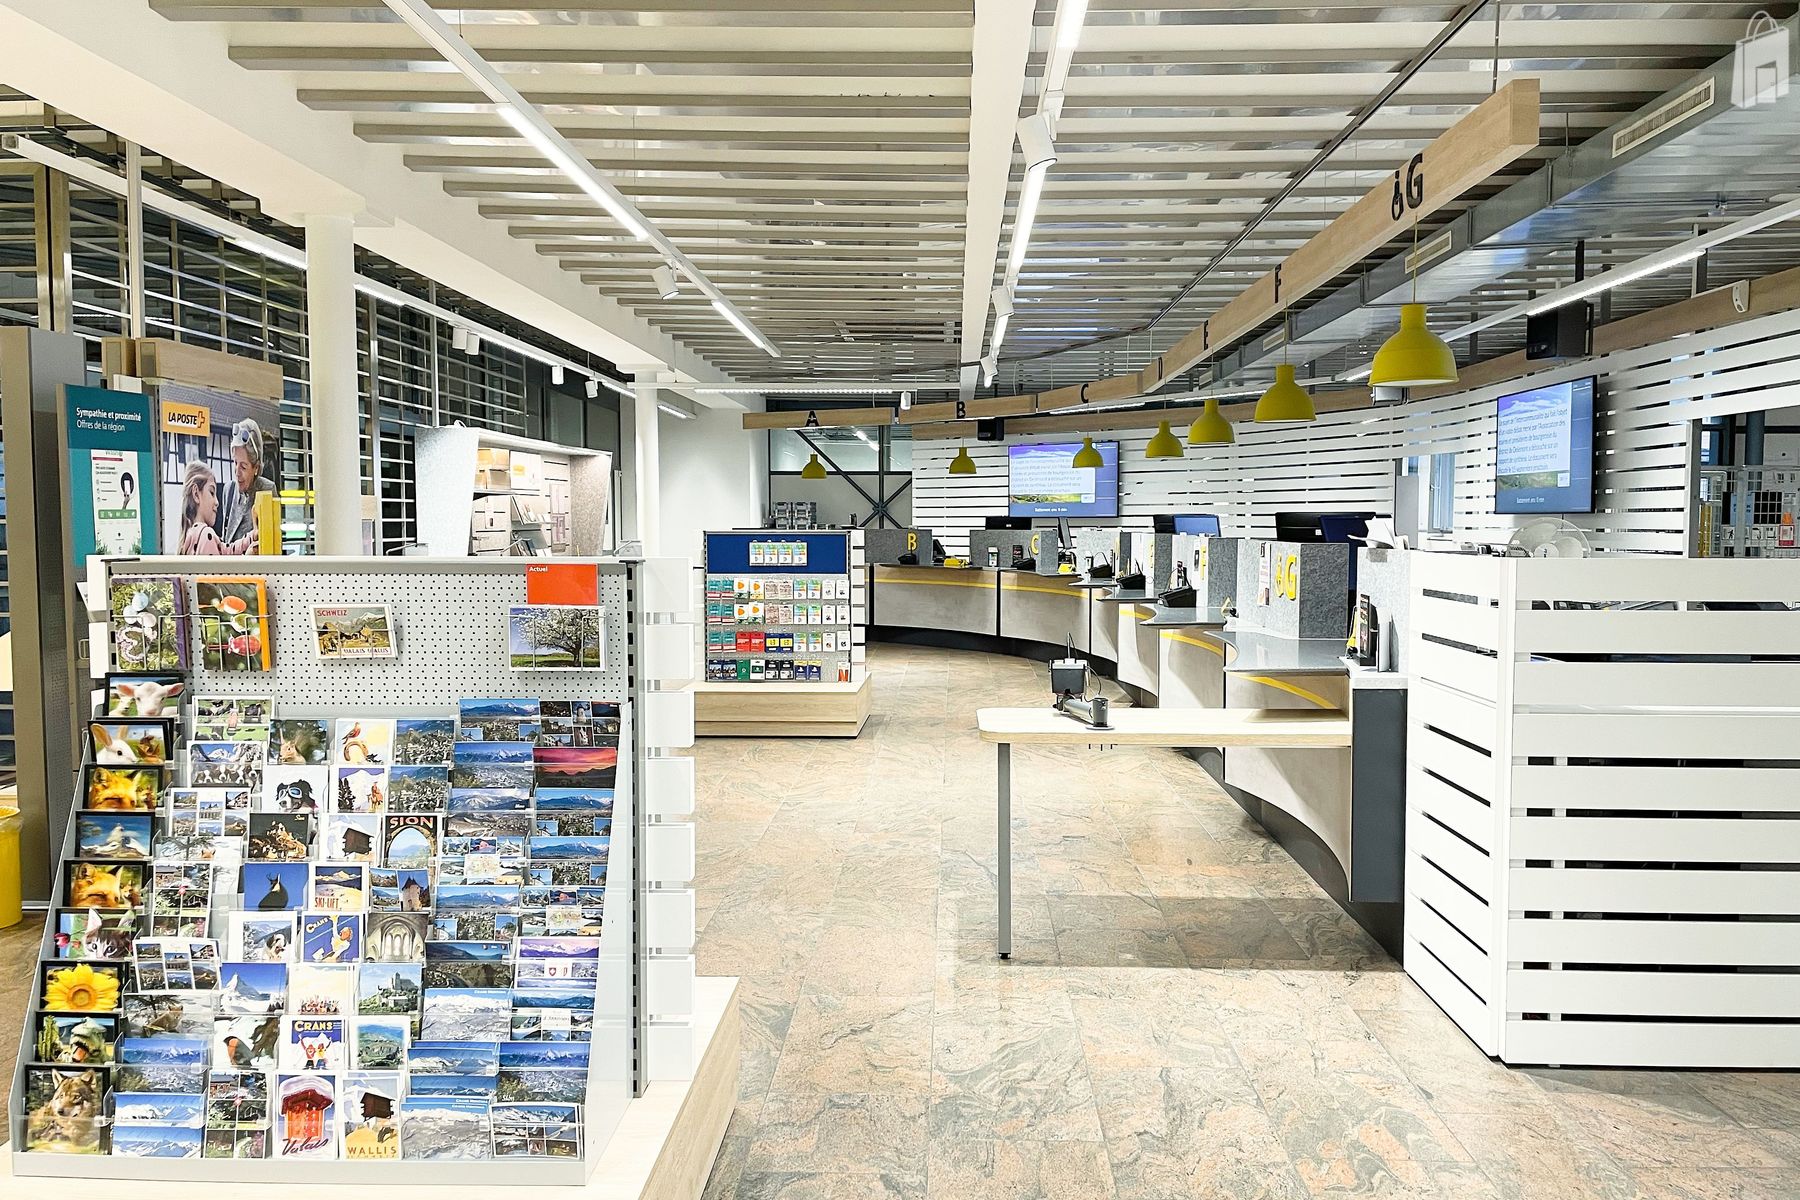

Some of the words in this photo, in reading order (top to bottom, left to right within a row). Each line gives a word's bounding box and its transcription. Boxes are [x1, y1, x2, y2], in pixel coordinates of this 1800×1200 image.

[1405, 152, 1424, 210] G
[1274, 263, 1282, 304] F
[1080, 383, 1089, 403] C
[76, 407, 107, 419] Sympathie
[108, 411, 114, 419] et
[114, 411, 141, 422] proximité
[168, 411, 176, 422] LA
[176, 413, 198, 425] POSTE
[805, 410, 820, 427] A
[956, 401, 966, 419] B
[76, 419, 93, 429] Offres
[94, 420, 101, 430] de
[102, 421, 107, 430] la
[108, 421, 125, 433] région
[906, 532, 918, 551] B
[1030, 534, 1040, 556] C
[1284, 553, 1298, 601] G
[317, 609, 348, 617] SCHWEIZ
[389, 816, 434, 829] SION
[281, 1136, 329, 1156] Valais
[347, 1146, 397, 1155] WALLIS
